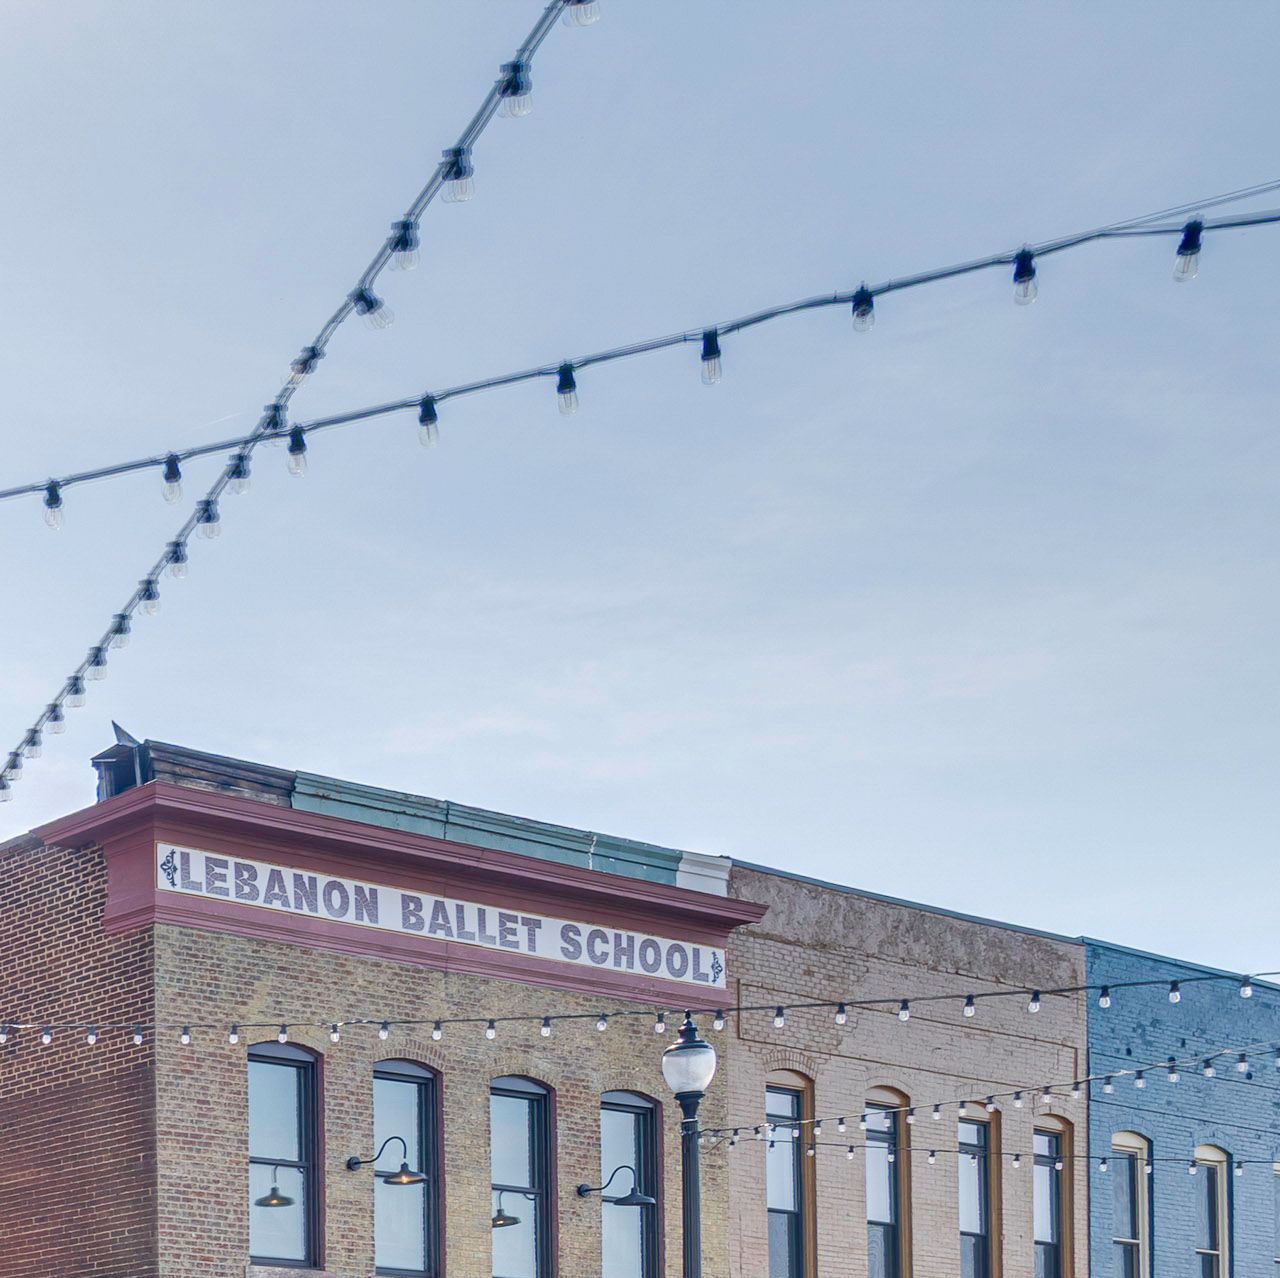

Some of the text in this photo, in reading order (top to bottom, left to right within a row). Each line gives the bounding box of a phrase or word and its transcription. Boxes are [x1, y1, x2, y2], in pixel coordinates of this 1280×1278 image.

[180, 851, 709, 982] LEBANON BALLET SCHOOL
